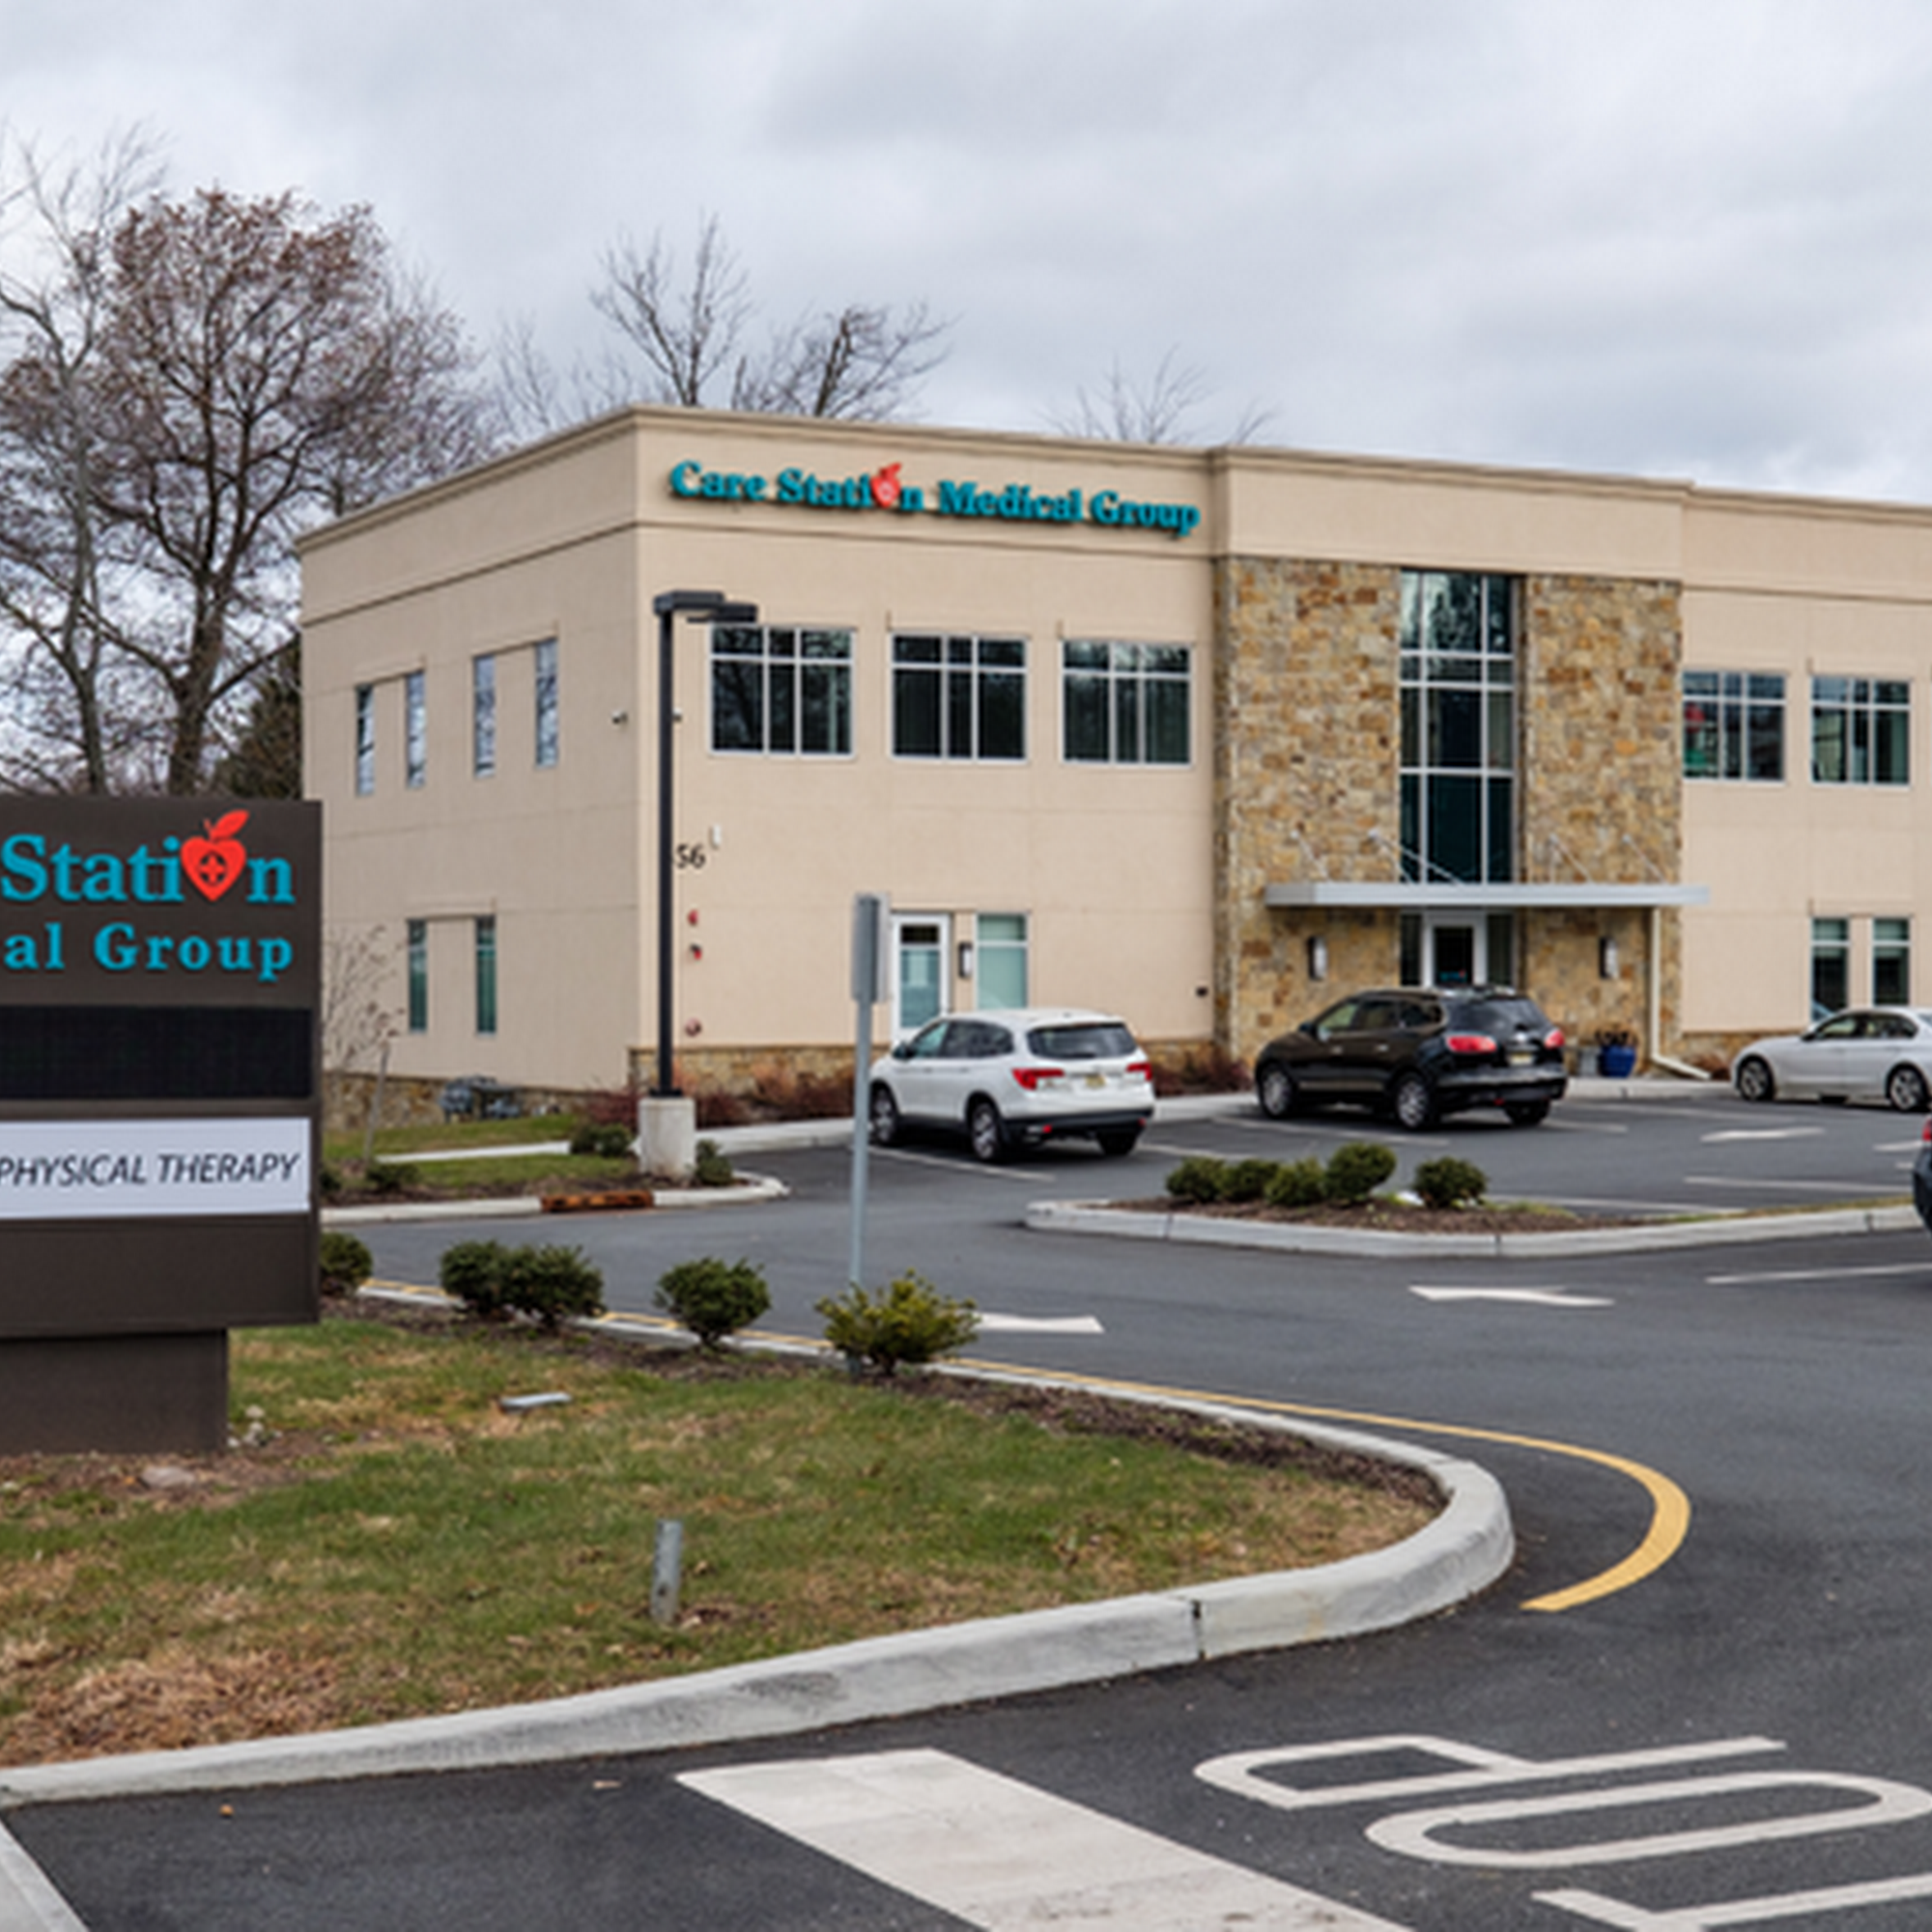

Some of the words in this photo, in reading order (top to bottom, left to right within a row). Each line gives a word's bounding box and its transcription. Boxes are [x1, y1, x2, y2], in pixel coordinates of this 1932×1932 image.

[670, 461, 768, 501] Care
[938, 480, 1084, 523] Medical
[1090, 490, 1202, 537] Group
[673, 842, 706, 869] 56
[94, 922, 294, 982] Group
[157, 1151, 300, 1184] THERAPY
